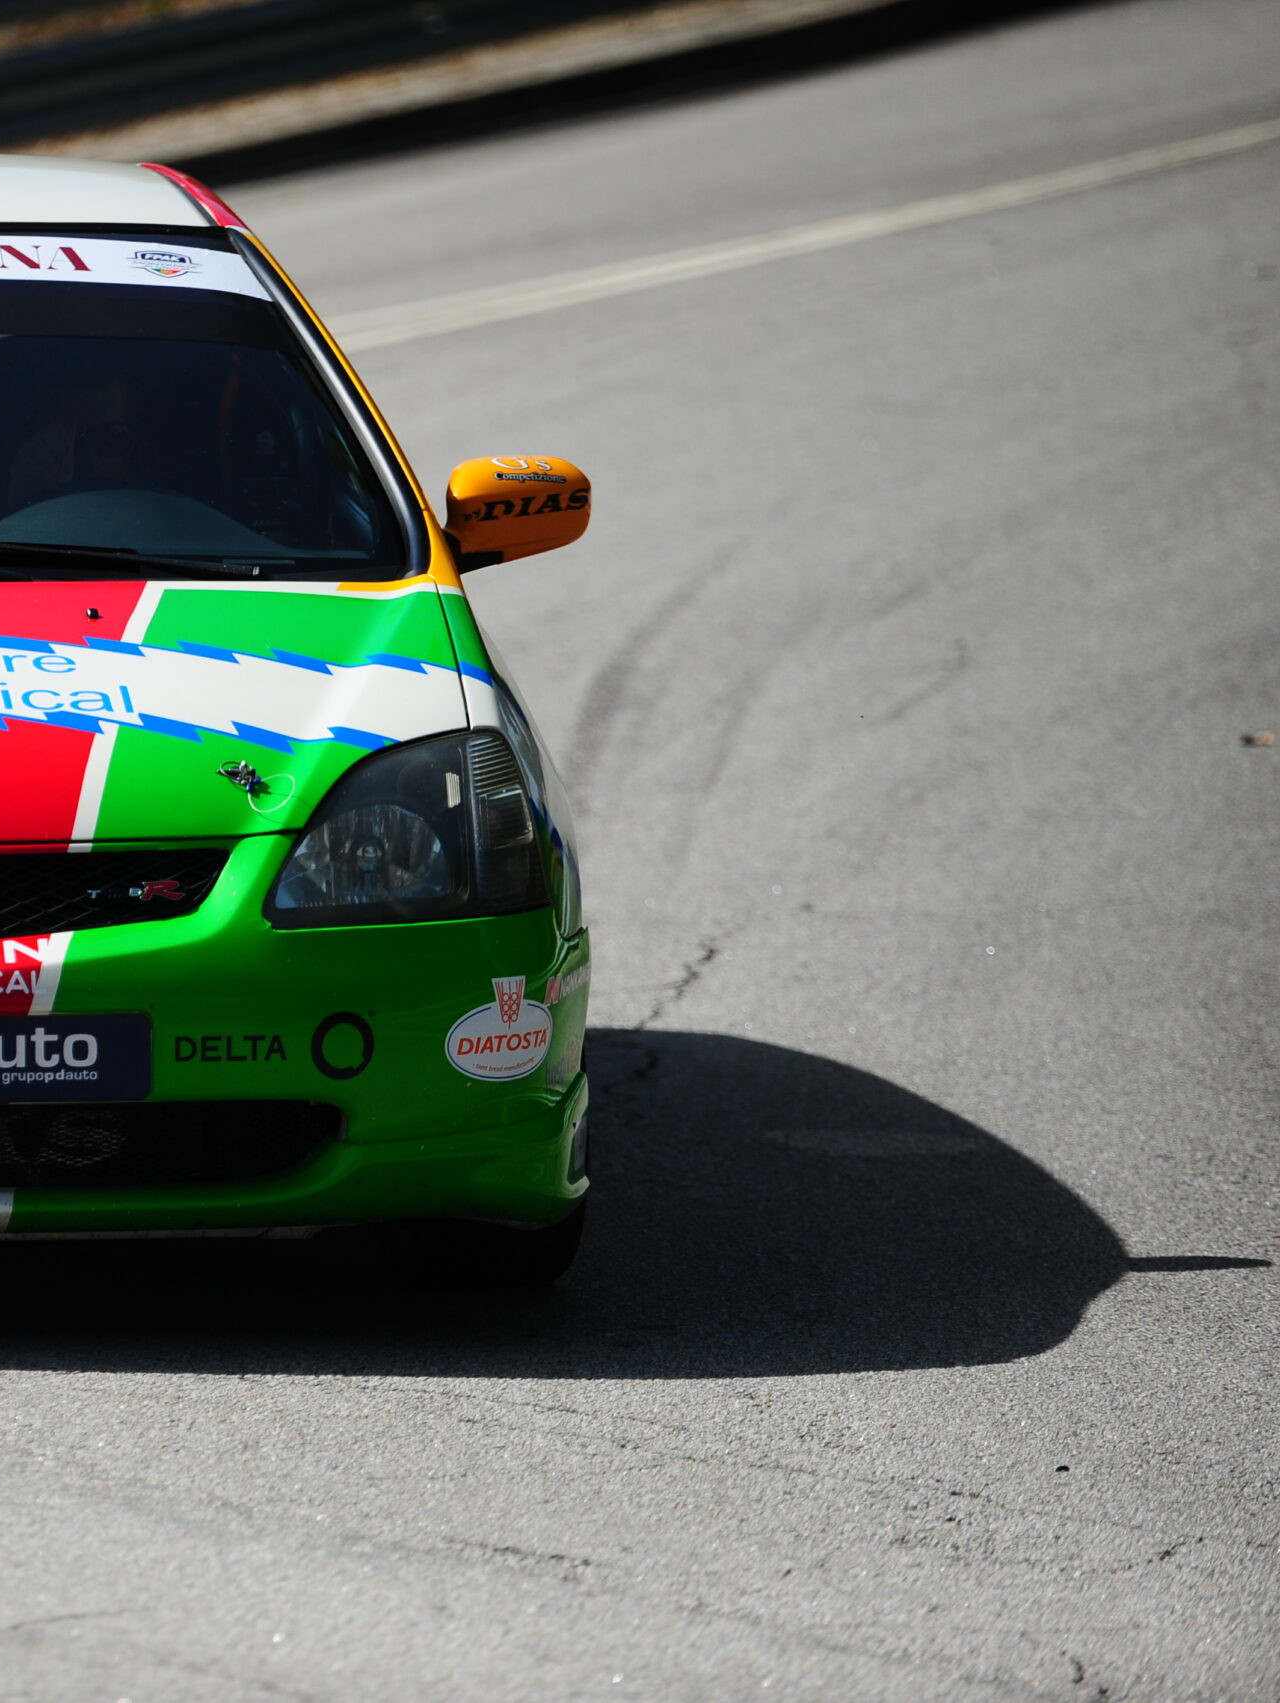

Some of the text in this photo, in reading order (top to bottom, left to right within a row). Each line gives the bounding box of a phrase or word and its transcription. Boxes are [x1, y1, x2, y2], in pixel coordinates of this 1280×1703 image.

[476, 488, 590, 522] DIAS
[174, 1035, 288, 1063] DELTA
[456, 1028, 548, 1056] DIATOSTA
[1, 1069, 98, 1085] grupopdauto
